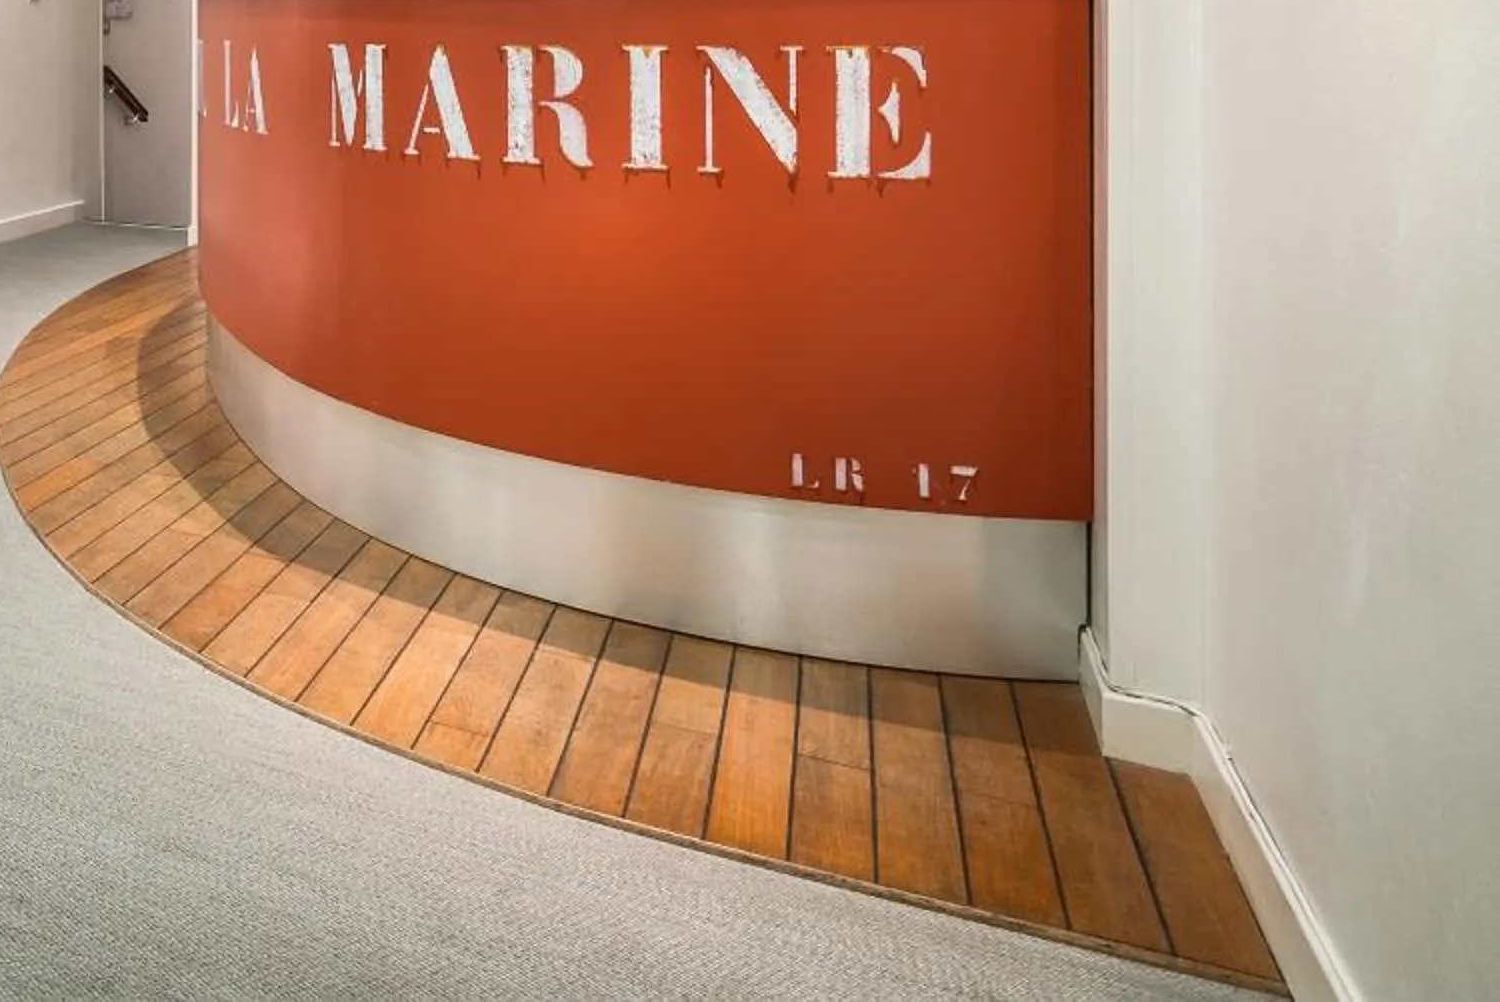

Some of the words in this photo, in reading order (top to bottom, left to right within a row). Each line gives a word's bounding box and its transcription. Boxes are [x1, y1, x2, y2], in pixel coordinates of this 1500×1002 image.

[222, 39, 270, 135] LA
[327, 43, 933, 180] MARINE
[791, 453, 865, 493] LR
[910, 463, 979, 501] 17
